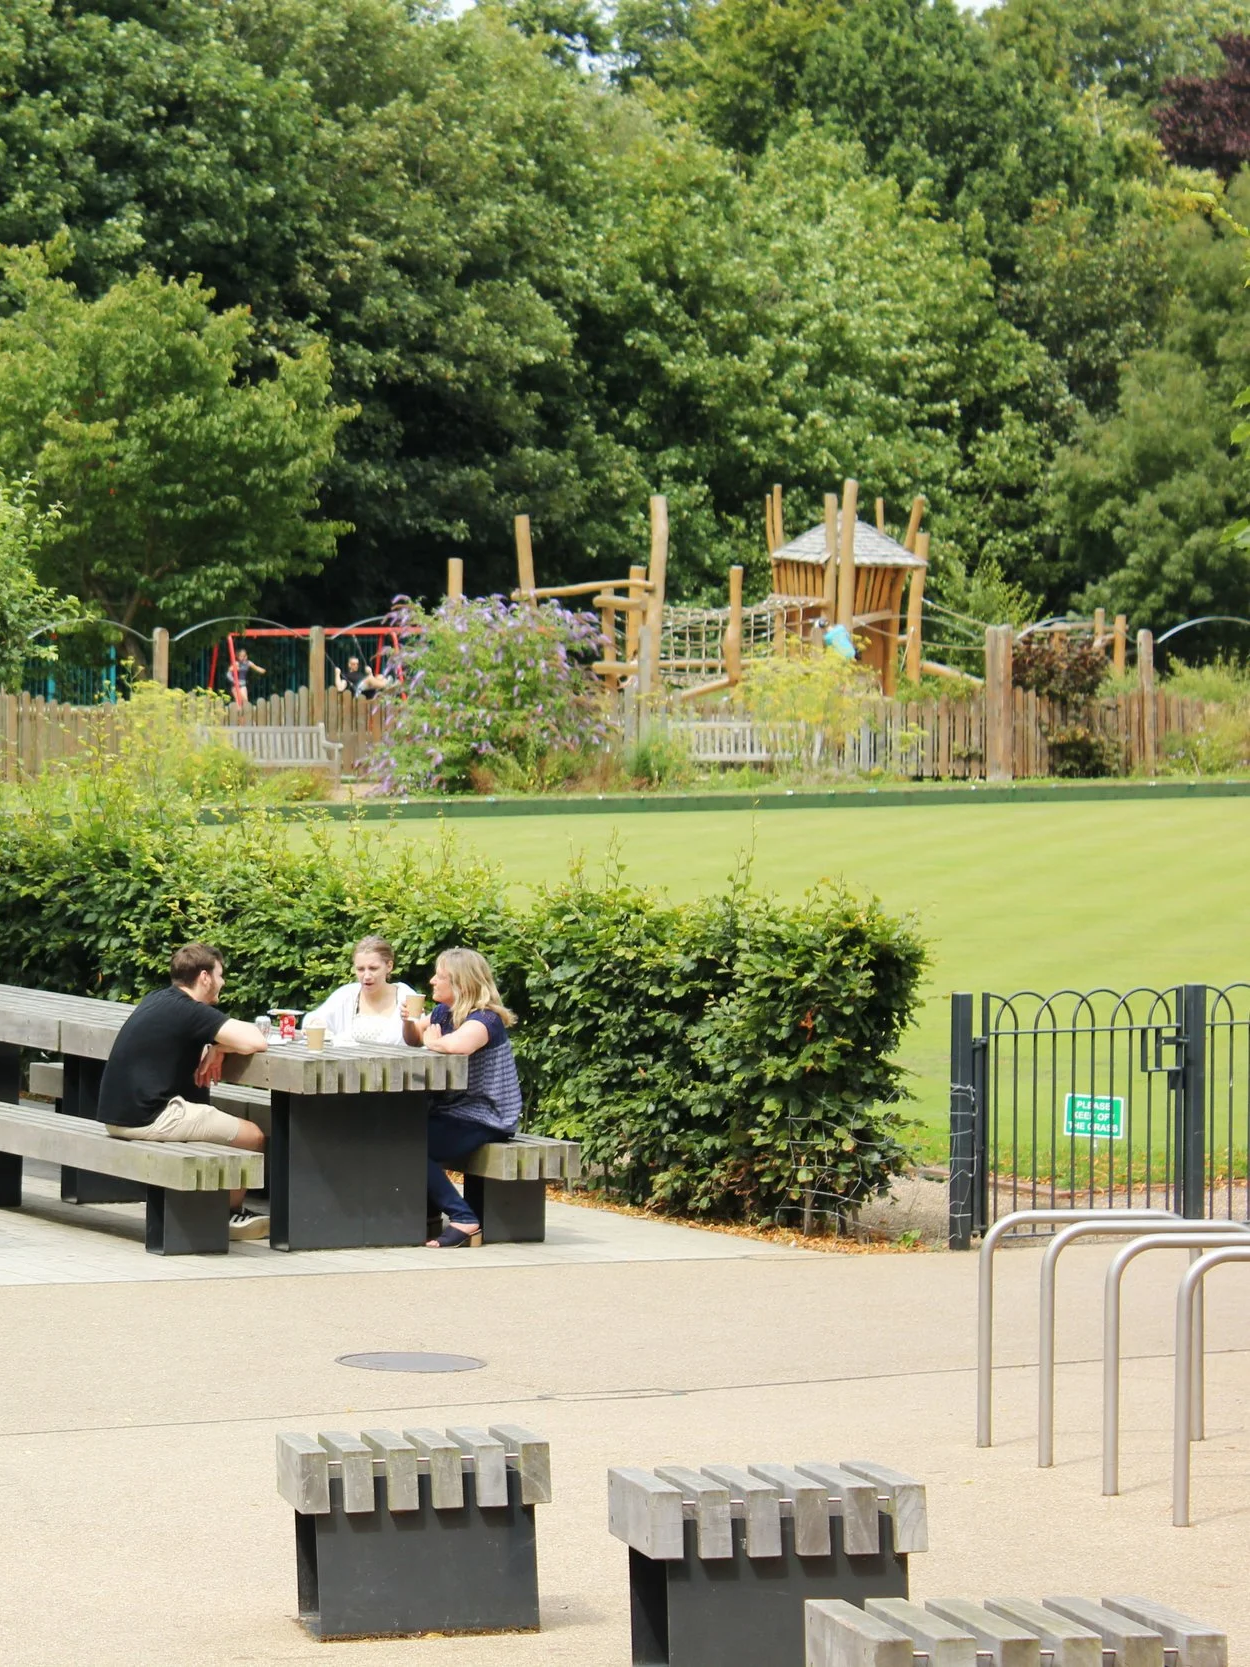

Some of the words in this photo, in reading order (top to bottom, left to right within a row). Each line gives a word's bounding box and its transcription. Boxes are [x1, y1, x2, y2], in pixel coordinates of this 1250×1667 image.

[1077, 1101, 1111, 1111] PLEASE
[1073, 1111, 1096, 1121] KEE
[1097, 1113, 1115, 1122] OF
